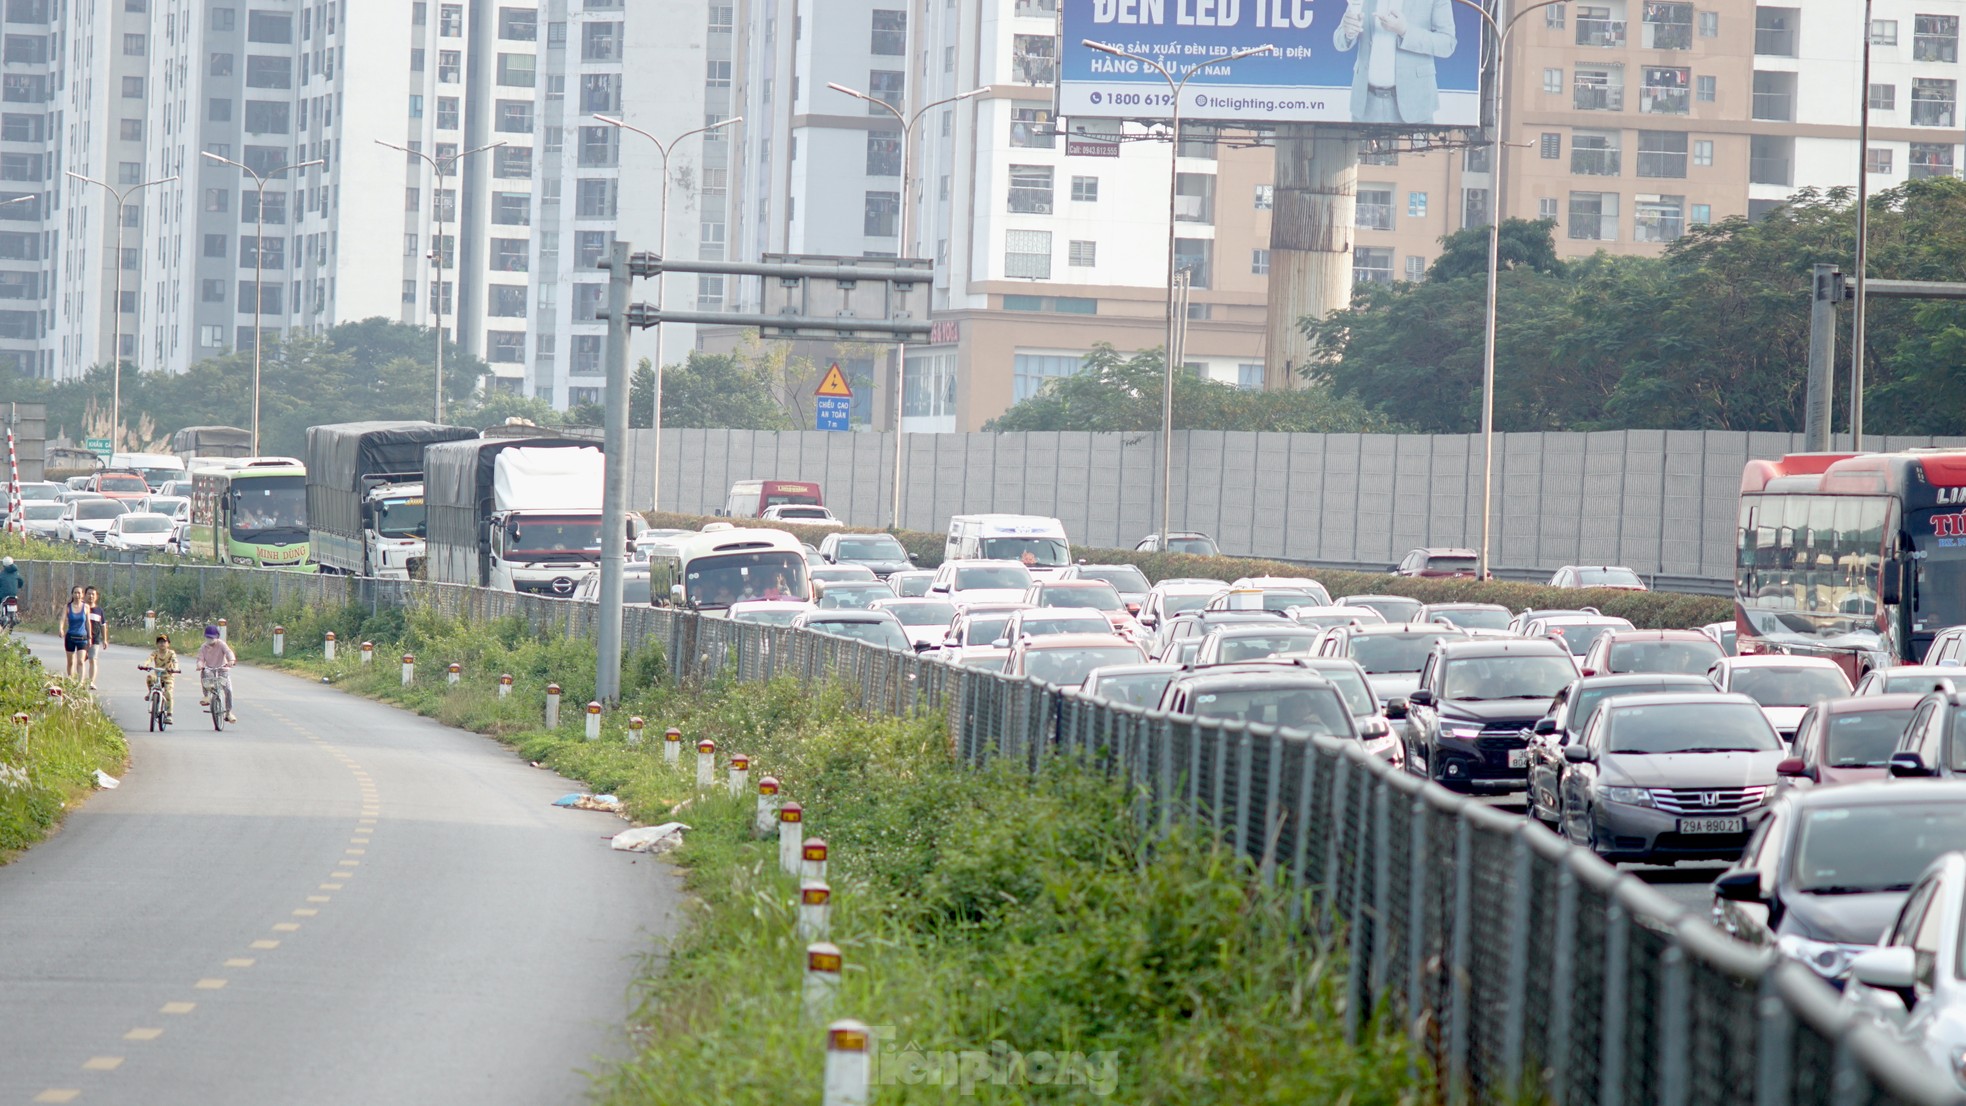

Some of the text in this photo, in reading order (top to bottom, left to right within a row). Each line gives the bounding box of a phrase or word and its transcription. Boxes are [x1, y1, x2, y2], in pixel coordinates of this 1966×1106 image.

[1177, 0, 1240, 26] LED
[1127, 41, 1149, 53] SẢN
[1153, 41, 1181, 54] XUẤT
[1184, 43, 1206, 55] ĐÈN
[1209, 46, 1228, 56] LED
[1272, 47, 1283, 60] BỊ
[1286, 46, 1311, 60] ĐIỆN
[1091, 56, 1138, 74] HÀNG
[1205, 65, 1231, 76] NAM
[1107, 93, 1140, 105] 1800
[1210, 97, 1325, 112] tlclighting.com.vn
[837, 401, 849, 409] CAO
[256, 546, 279, 560] MINH
